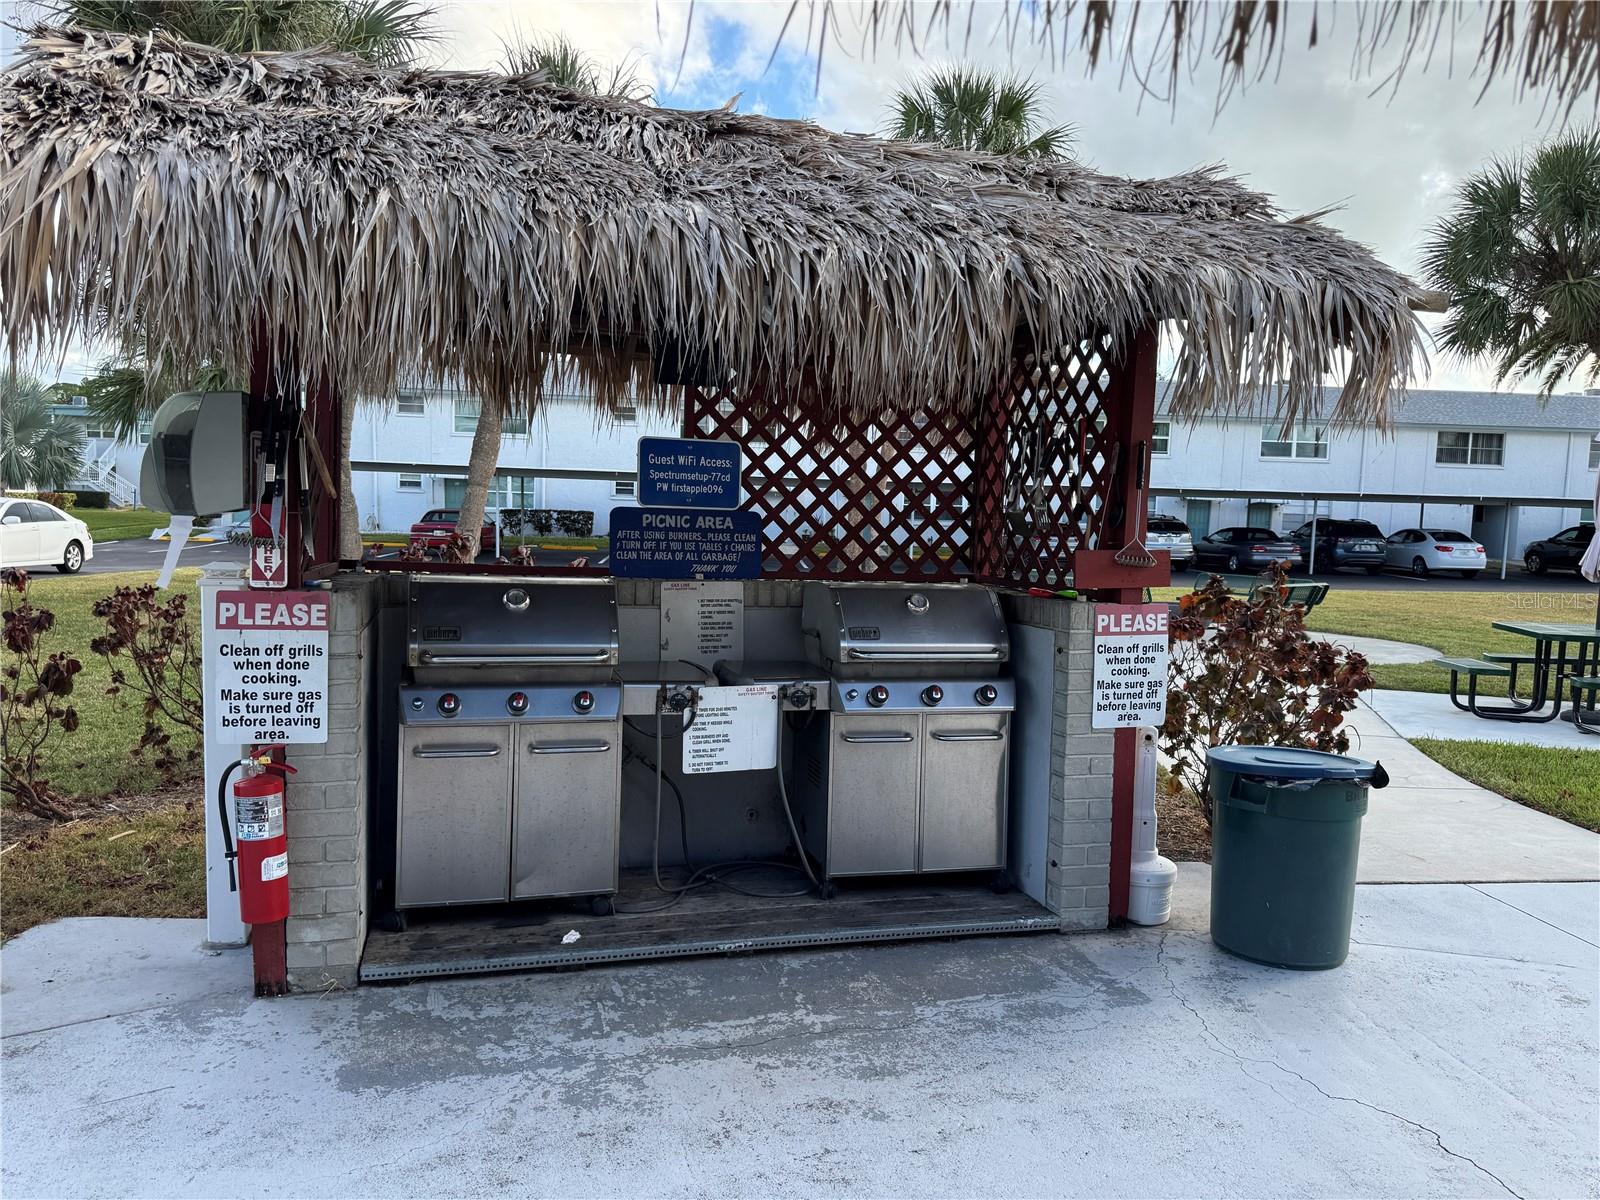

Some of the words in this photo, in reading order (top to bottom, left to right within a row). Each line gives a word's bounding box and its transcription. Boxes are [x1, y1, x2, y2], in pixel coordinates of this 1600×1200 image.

[648, 453, 674, 464] Guest
[678, 455, 696, 466] WiFi
[700, 456, 733, 468] Access:
[656, 482, 668, 492] PW
[671, 483, 723, 494] firstapple096
[642, 514, 690, 528] PICNIC
[696, 516, 734, 529] AREA
[616, 530, 640, 539] AFTER
[644, 531, 665, 540] USING
[708, 533, 730, 541] PLEASE
[734, 533, 756, 542] CLEAN
[622, 541, 640, 549] TURN
[669, 542, 682, 550] YOU
[684, 542, 696, 550] USE
[698, 542, 722, 551] TABLES
[730, 543, 755, 551] CHAIRS
[616, 551, 637, 560] CLEAN
[640, 551, 652, 560] THE
[654, 552, 672, 560] AREA
[675, 552, 684, 560] OF
[686, 552, 698, 560] ALL
[701, 552, 741, 563] GARBAGE!
[690, 564, 719, 572] THANK
[721, 564, 738, 573] YOU
[219, 602, 326, 626] PLEASE
[1097, 613, 1168, 632] PLEASE
[220, 644, 260, 656] Clean
[264, 644, 284, 656] off
[288, 644, 323, 659] grills
[1097, 644, 1124, 654] Clean
[1126, 644, 1140, 654] off
[1142, 643, 1164, 655] grills
[233, 658, 271, 670] when
[276, 658, 310, 670] done
[1105, 656, 1130, 665] when
[1133, 655, 1156, 664] done
[1111, 666, 1150, 677] cooking.
[242, 672, 301, 686] cooking.
[1096, 680, 1121, 690] Make
[1147, 680, 1163, 690] gas
[220, 689, 258, 700] Make
[262, 691, 293, 700] sure
[298, 691, 322, 703] gas
[1102, 692, 1110, 700] is
[1112, 690, 1143, 700] turned
[1145, 689, 1158, 698] off
[228, 703, 240, 714] is
[245, 702, 291, 714] turned
[296, 702, 314, 714] off
[1096, 702, 1126, 711] before
[1130, 700, 1161, 711] leaving
[222, 716, 266, 727] before
[271, 716, 320, 729] leaving
[1117, 713, 1141, 721] area.
[254, 730, 289, 739] area.
